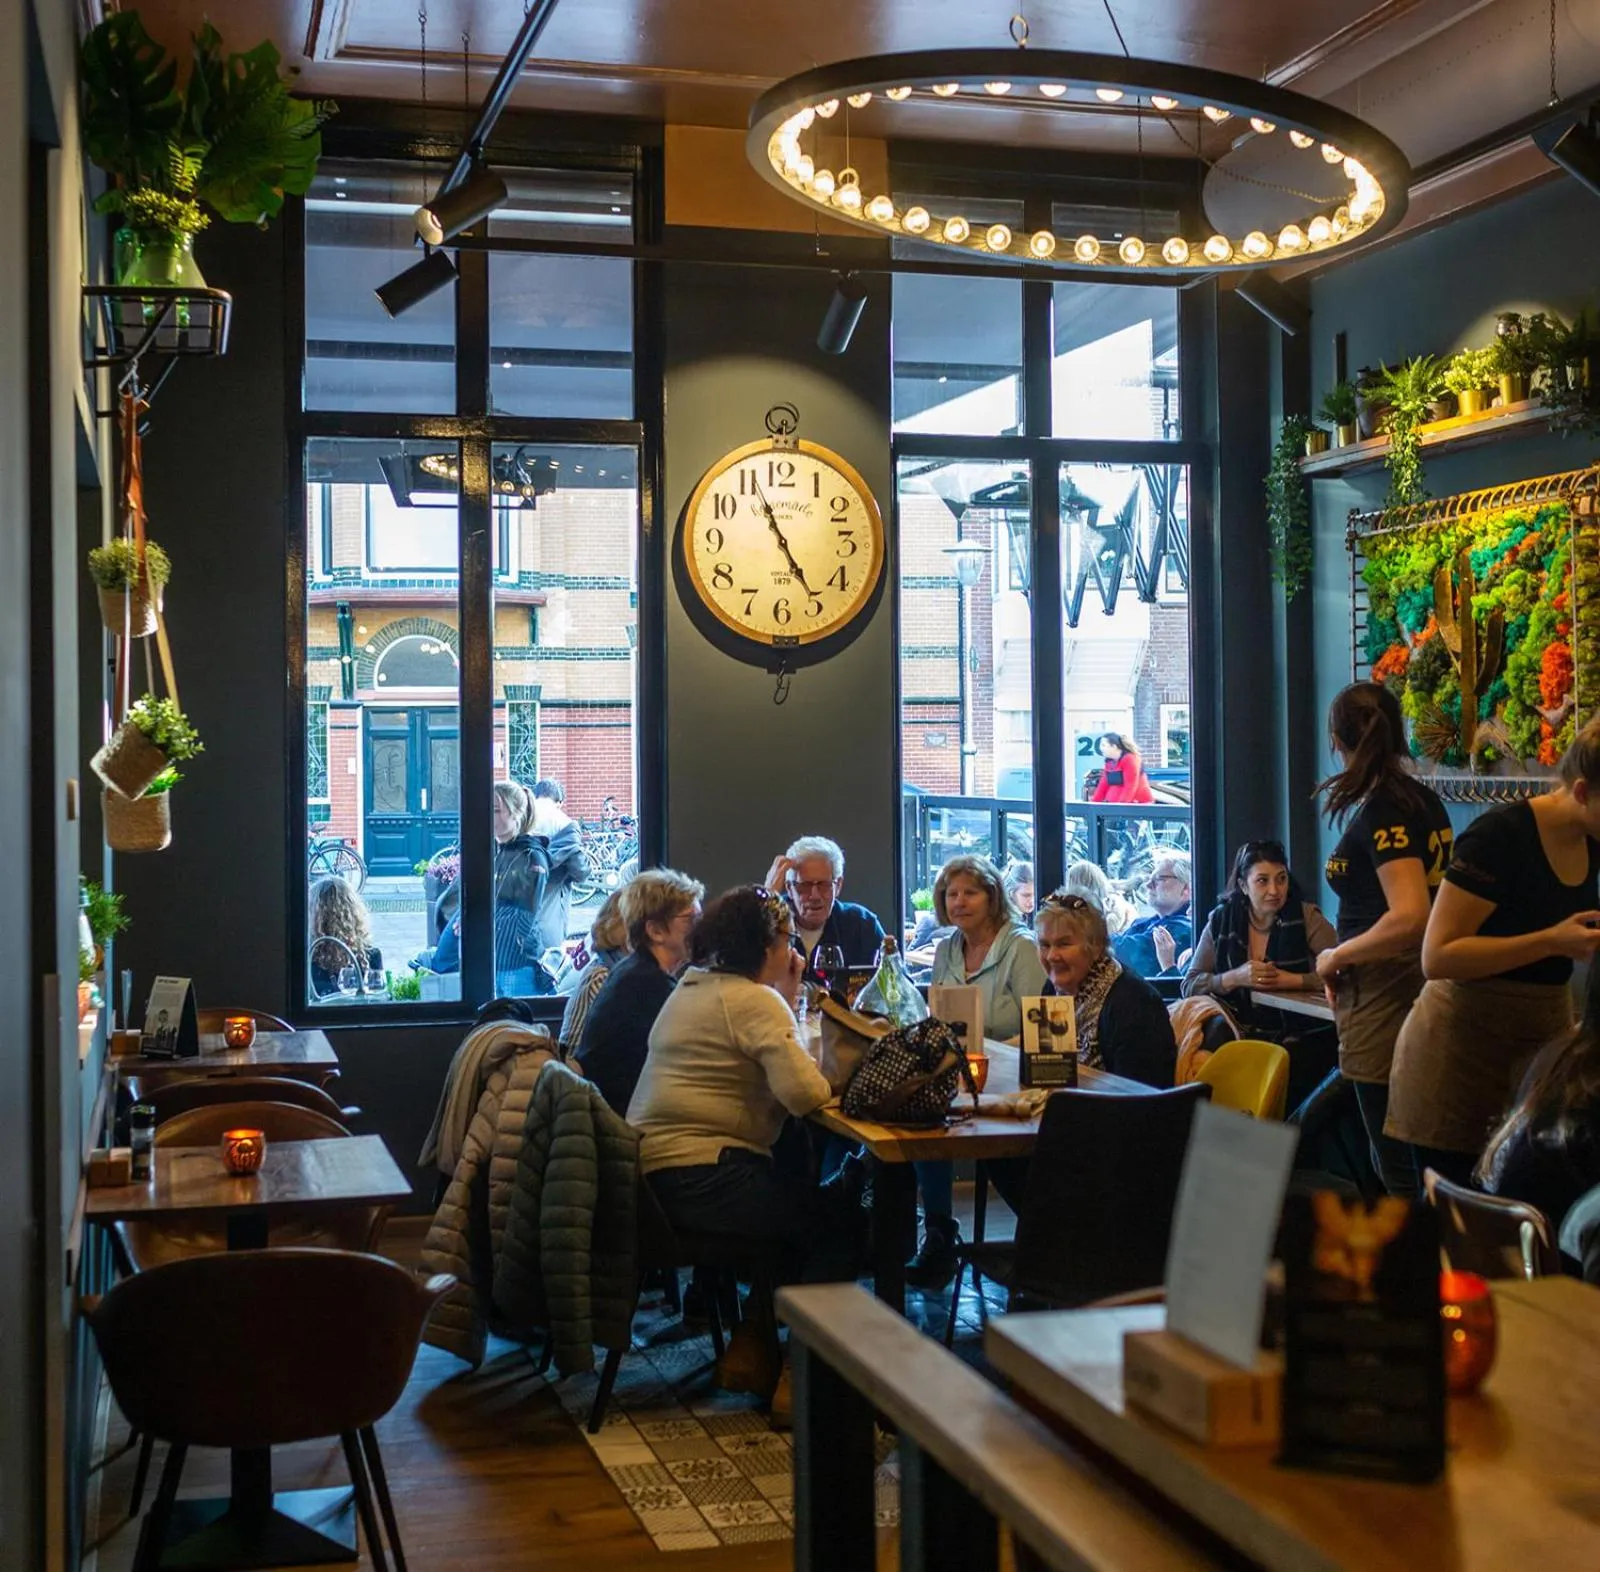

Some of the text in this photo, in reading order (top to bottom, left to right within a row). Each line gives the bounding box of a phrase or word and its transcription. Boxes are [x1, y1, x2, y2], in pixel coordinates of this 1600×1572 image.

[740, 469, 757, 496] 11
[768, 461, 796, 488] 12
[812, 472, 820, 498] 1
[713, 493, 737, 520] 10
[830, 496, 850, 523] 2
[705, 528, 724, 555] 9
[836, 530, 857, 558] 3
[711, 562, 734, 591] 8
[826, 565, 849, 592] 4
[740, 588, 759, 616] 7
[773, 598, 792, 626] 6
[804, 590, 824, 618] 5
[1373, 825, 1410, 851] 23
